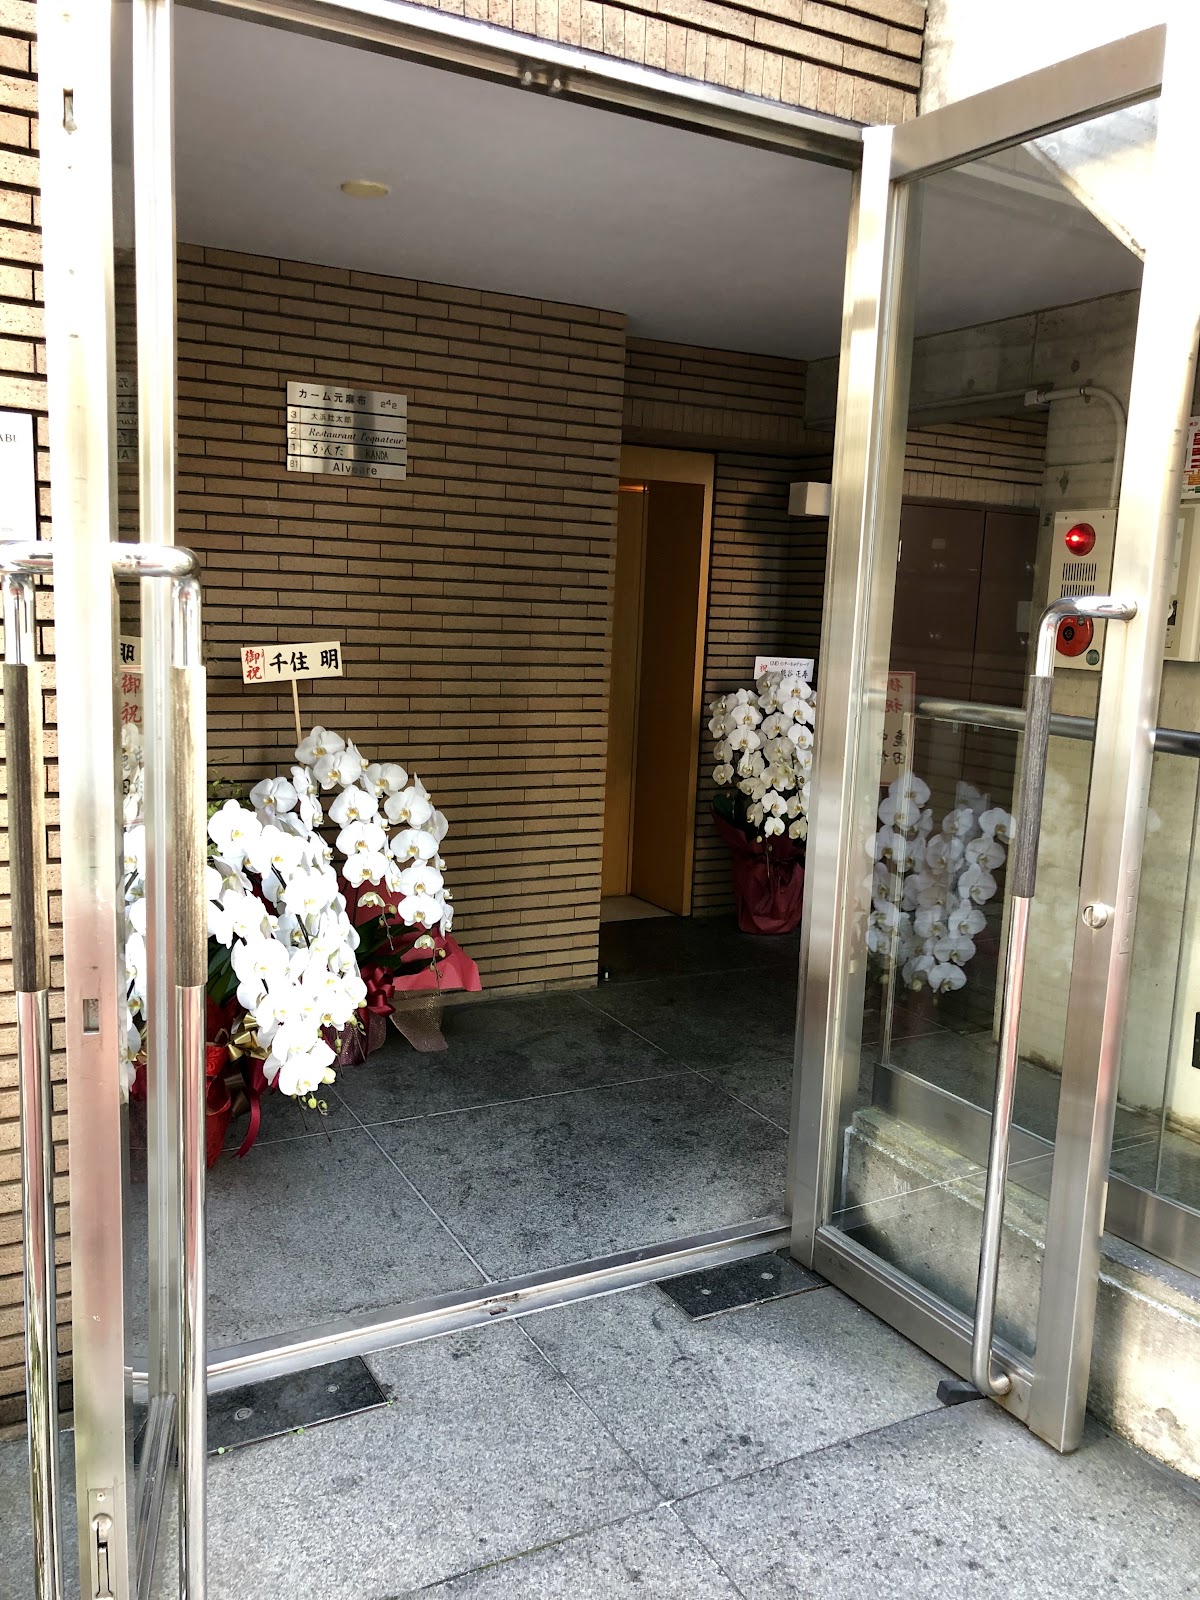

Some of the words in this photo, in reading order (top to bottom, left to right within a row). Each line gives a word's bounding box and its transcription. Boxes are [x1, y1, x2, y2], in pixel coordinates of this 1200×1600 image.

[299, 388, 366, 406] カーム元麻布
[290, 410, 297, 419] 3
[290, 427, 297, 435] 2
[308, 427, 357, 440] Restaurant
[291, 443, 297, 451] 1
[312, 443, 346, 456] かんだ
[365, 449, 389, 461] KANDA
[332, 462, 378, 476] Alveare
[244, 649, 263, 681] 御祝
[121, 673, 143, 724] 御祝
